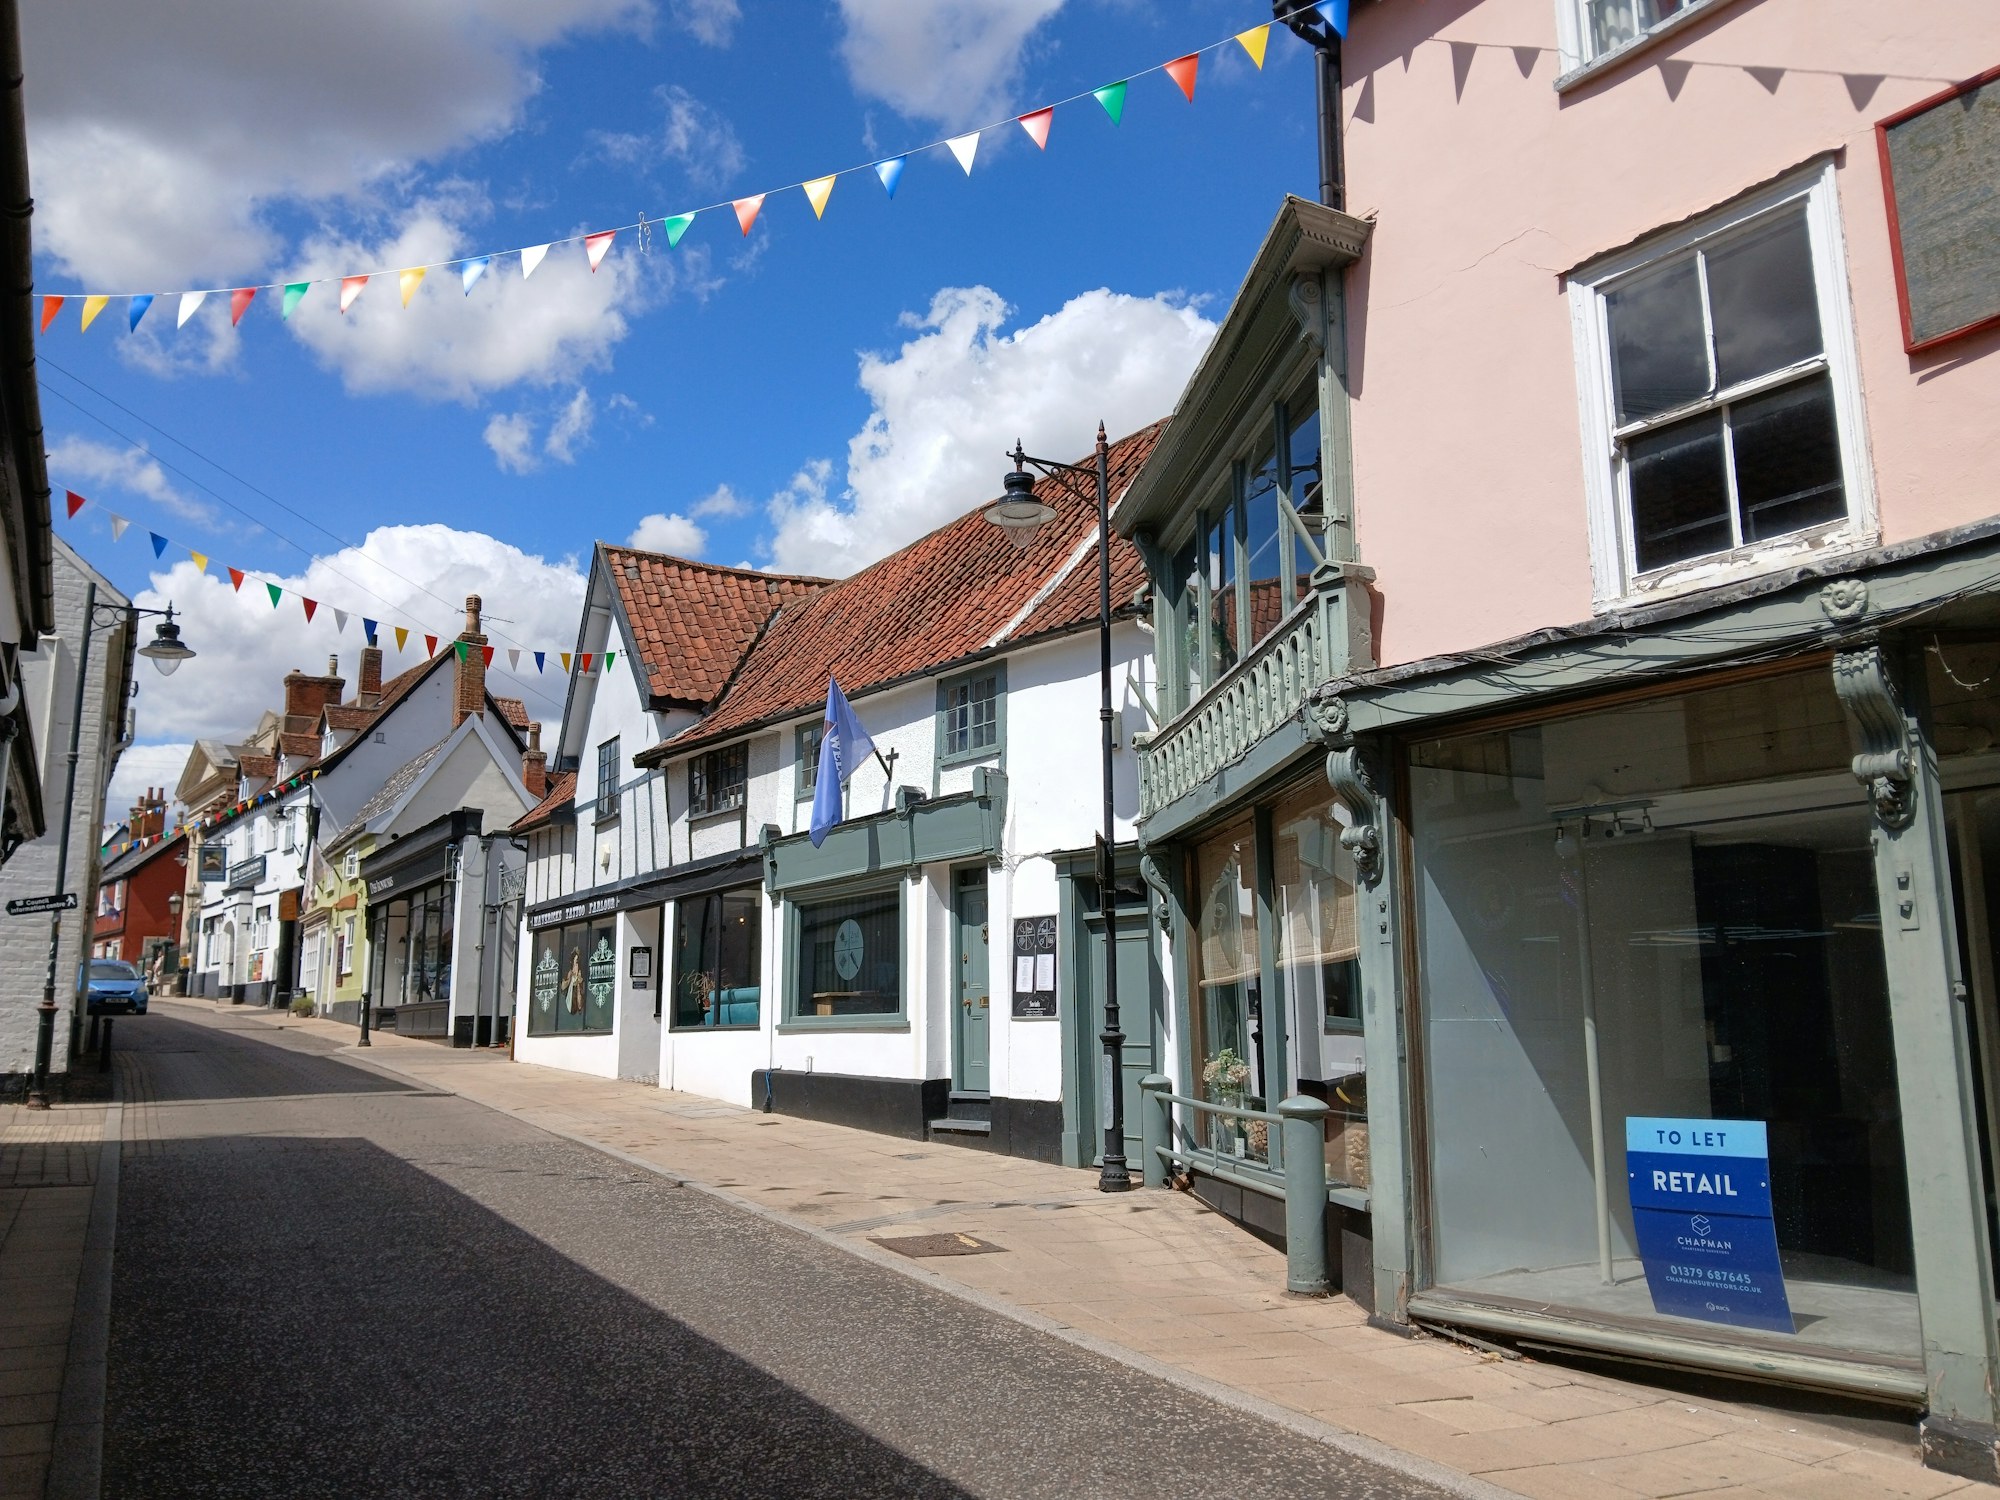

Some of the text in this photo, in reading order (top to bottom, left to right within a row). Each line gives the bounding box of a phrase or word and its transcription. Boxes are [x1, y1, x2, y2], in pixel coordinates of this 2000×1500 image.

[26, 898, 50, 906] Council
[46, 902, 66, 910] centre
[565, 904, 586, 920] TATTOO
[589, 897, 615, 914] PARLOUR
[1656, 1130, 1727, 1147] TO LET
[1652, 1170, 1738, 1197] RETAIL
[1677, 1236, 1732, 1250] CHAPMAN
[1670, 1265, 1752, 1284] 01379 687645
[1665, 1275, 1762, 1294] CHAPMANSURVEYORS.CO.UK
